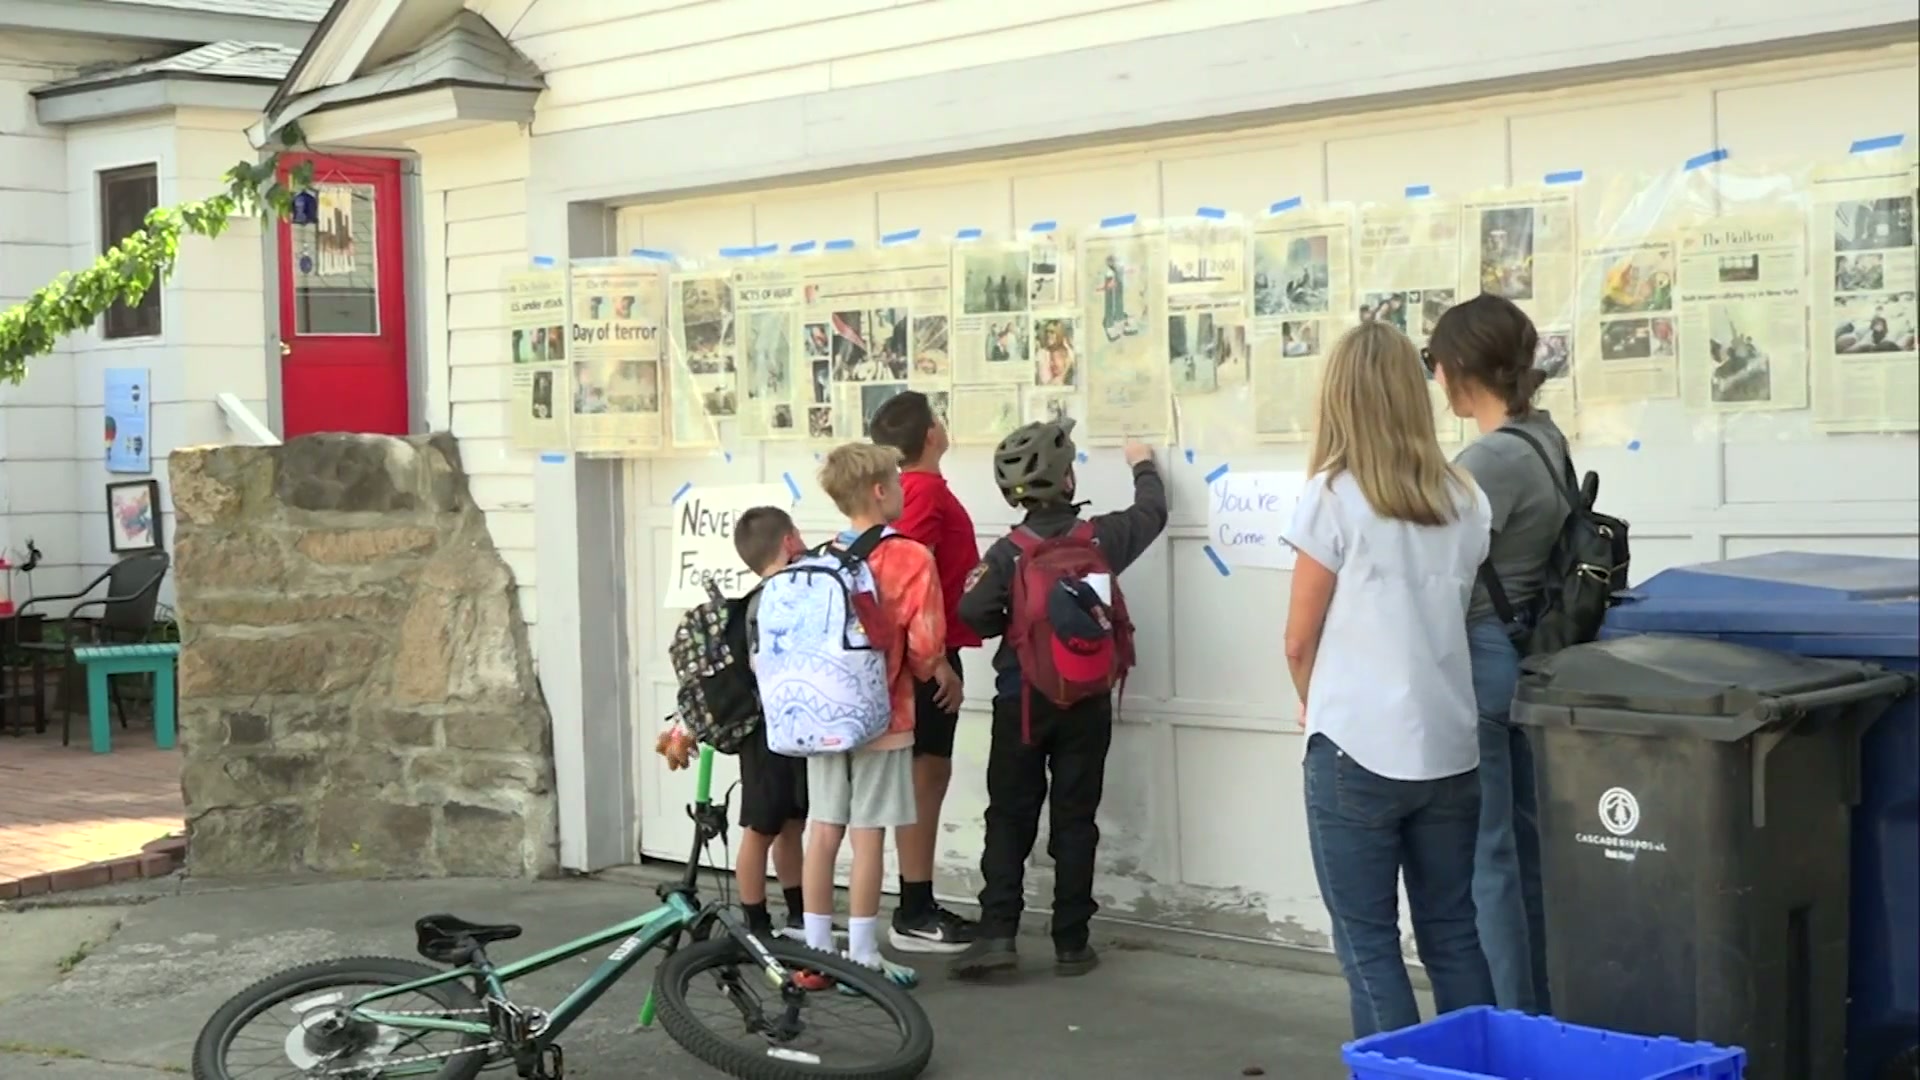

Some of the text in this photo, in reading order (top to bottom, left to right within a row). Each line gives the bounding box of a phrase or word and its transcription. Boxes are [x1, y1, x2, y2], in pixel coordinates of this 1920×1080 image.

[573, 321, 657, 344] Day of terror
[1215, 479, 1281, 514] You're
[1219, 522, 1266, 547] Come
